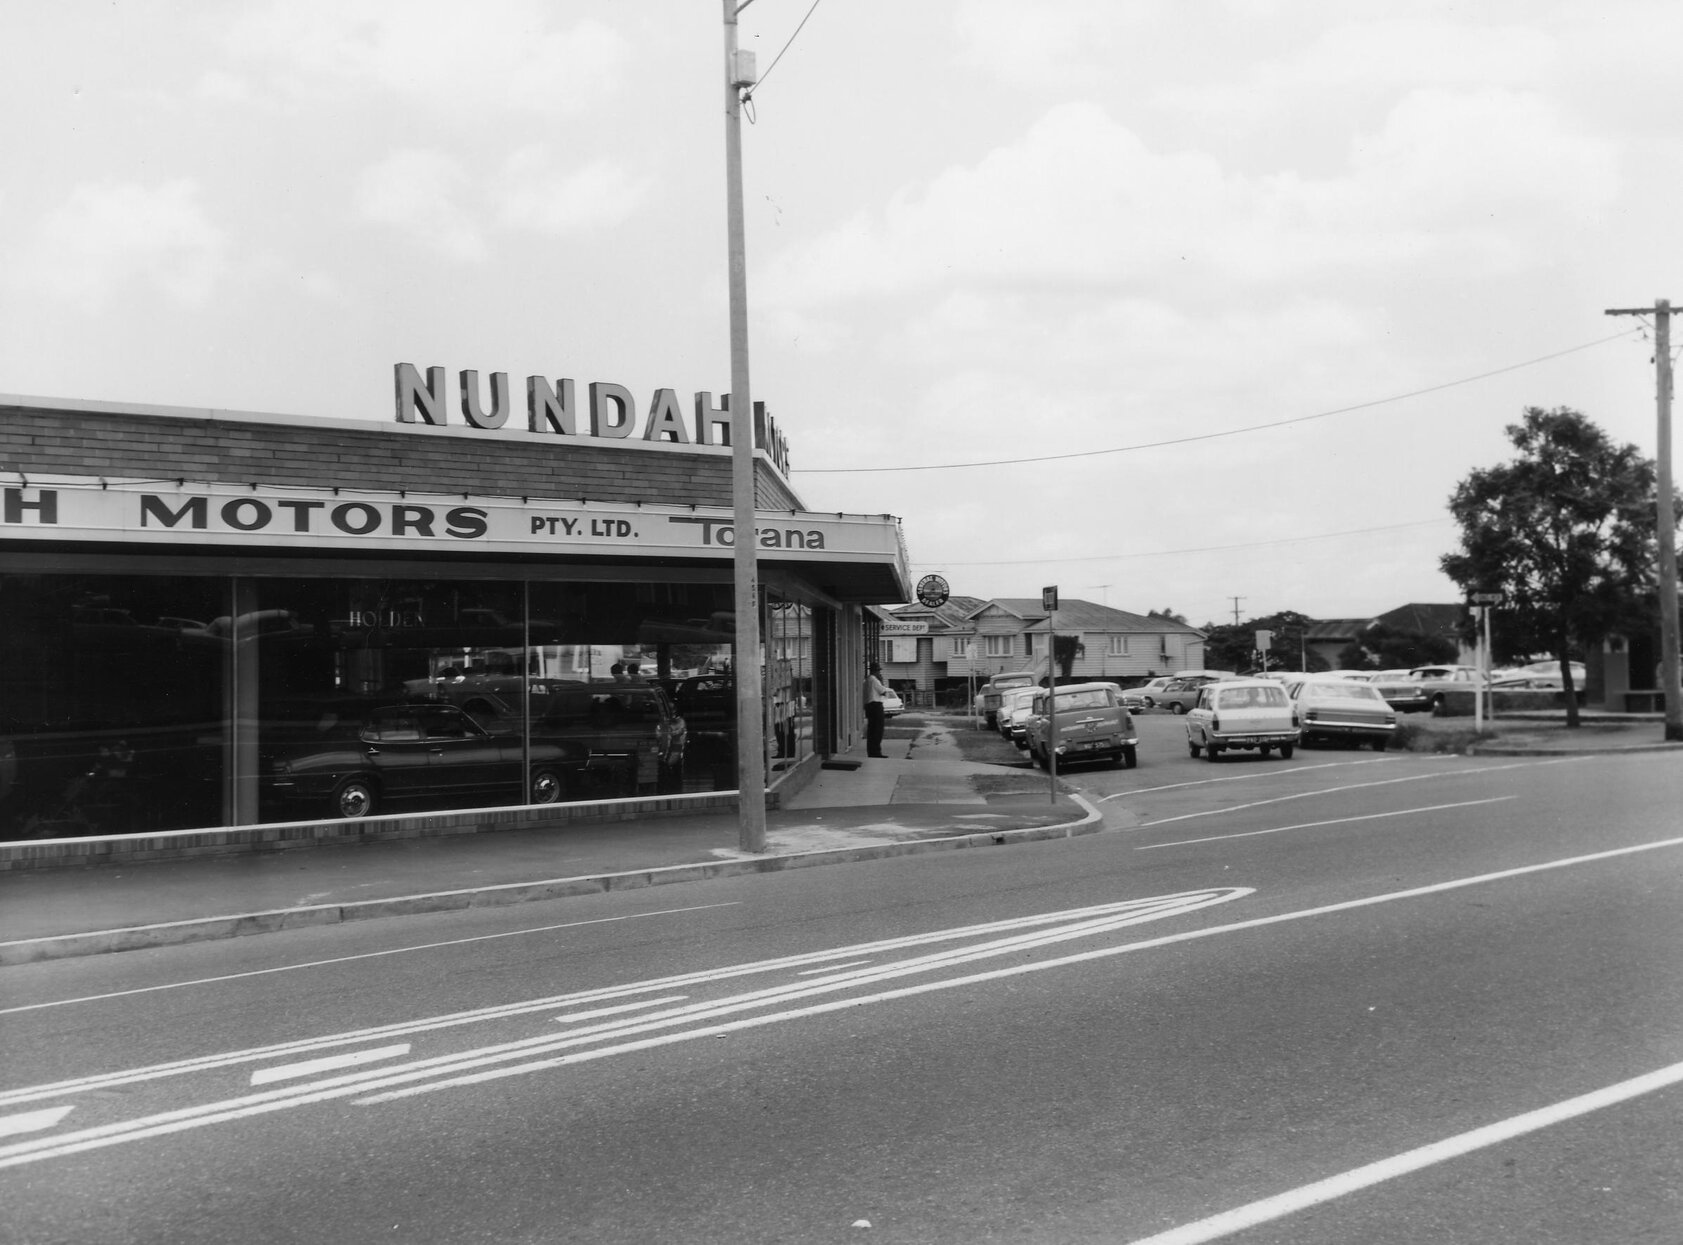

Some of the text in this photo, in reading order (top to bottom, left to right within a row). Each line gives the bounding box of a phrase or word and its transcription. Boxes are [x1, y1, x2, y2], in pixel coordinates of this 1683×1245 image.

[394, 362, 732, 445] NUNDAH
[3, 487, 640, 539] H MOTORS PTY. LTD.
[669, 517, 825, 550] Toana
[885, 624, 910, 632] SERVICE
